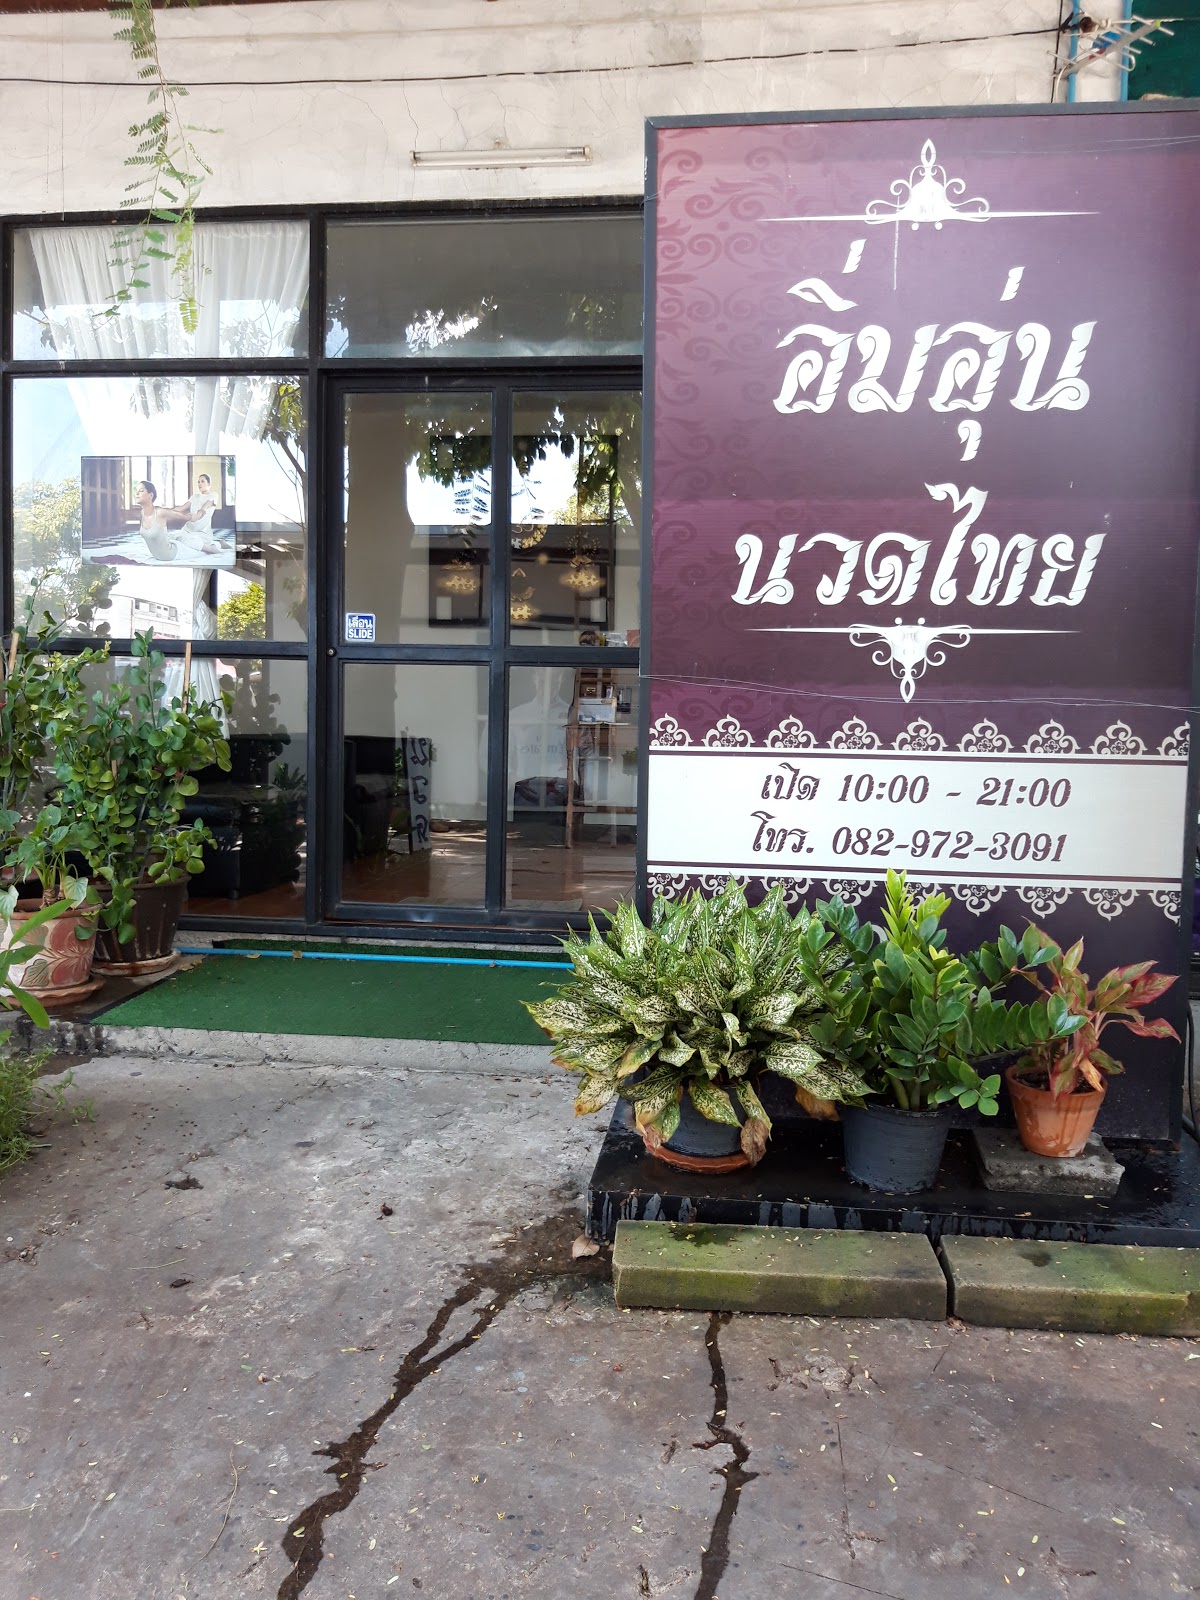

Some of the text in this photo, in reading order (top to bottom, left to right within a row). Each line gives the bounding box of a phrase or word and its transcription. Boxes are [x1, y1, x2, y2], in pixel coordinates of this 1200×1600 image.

[773, 239, 1098, 461] อิ่มอุ่น
[731, 482, 1107, 606] นวดไทย
[348, 628, 373, 639] SLIDE
[760, 762, 821, 801] เปิด
[837, 773, 930, 804] 10:00
[976, 777, 1072, 808] 21:00
[750, 810, 1068, 863] โทร. 082-972-3091
